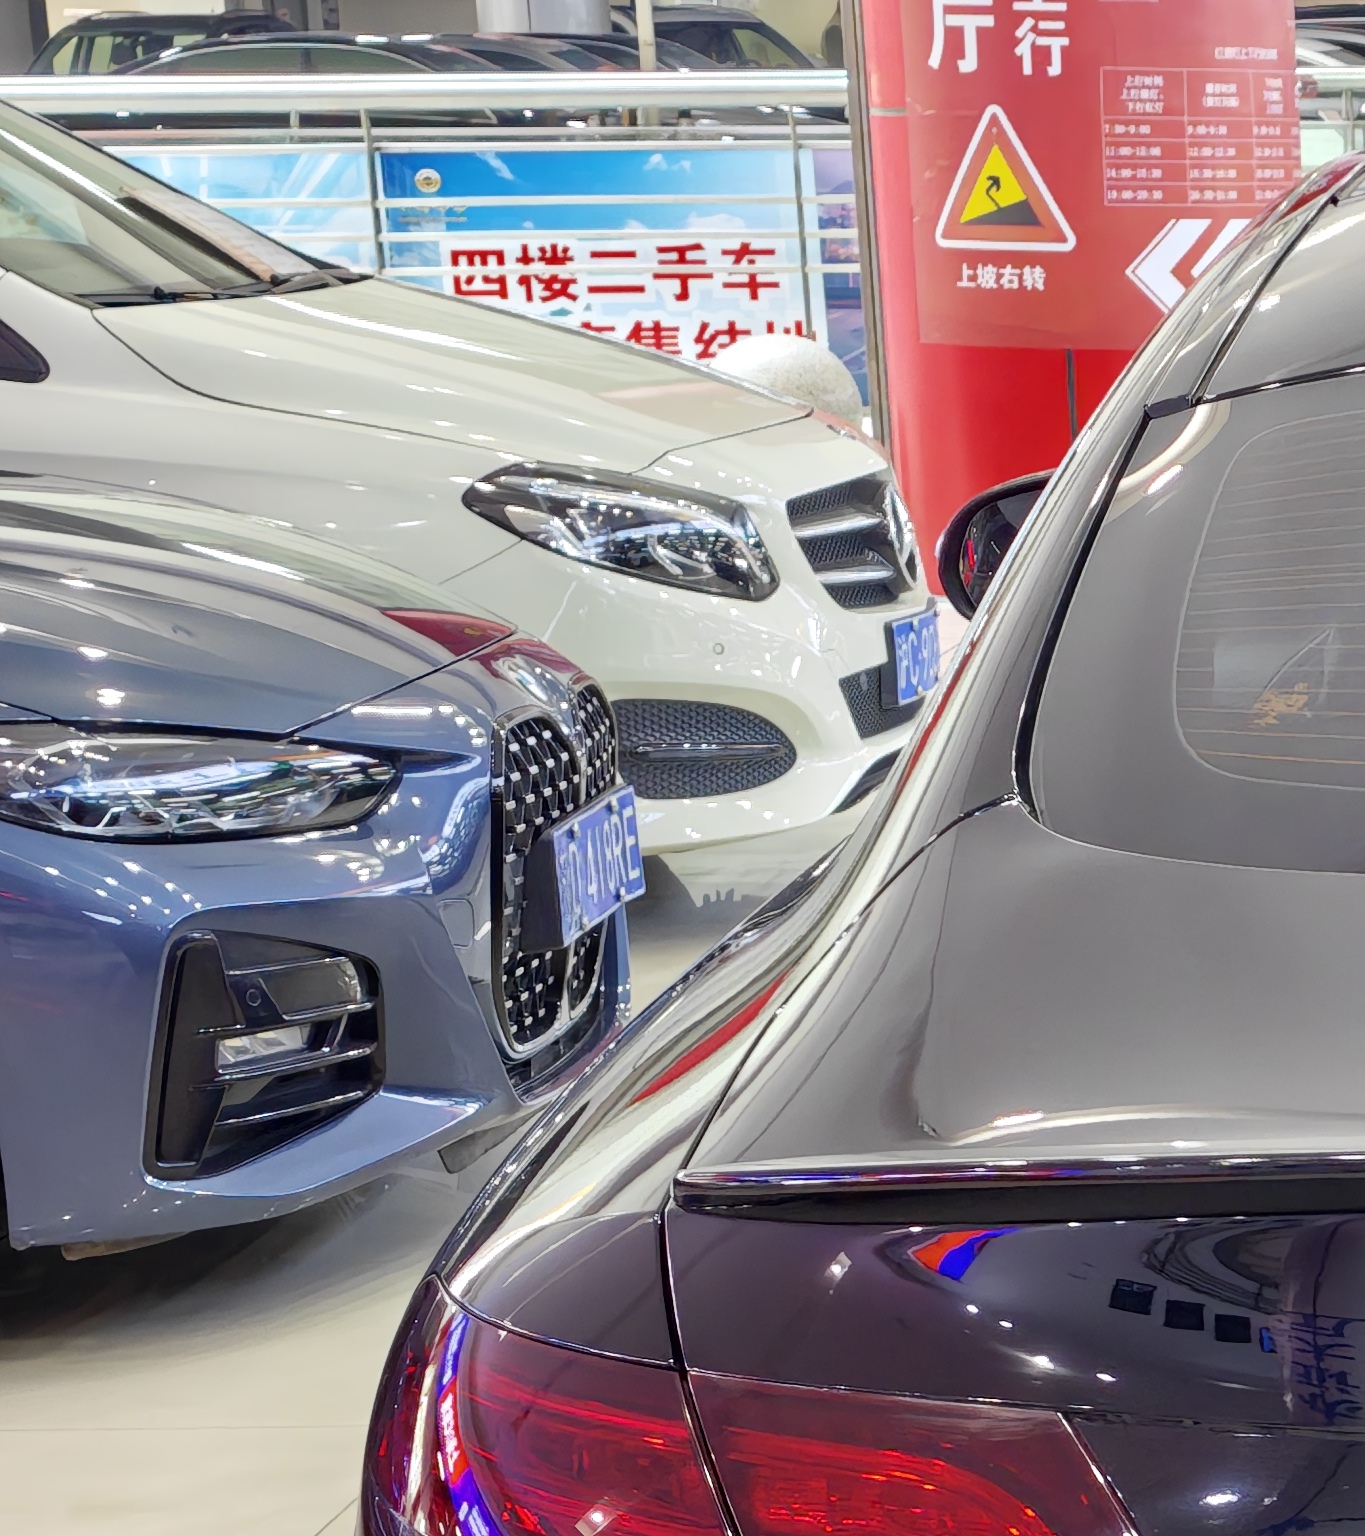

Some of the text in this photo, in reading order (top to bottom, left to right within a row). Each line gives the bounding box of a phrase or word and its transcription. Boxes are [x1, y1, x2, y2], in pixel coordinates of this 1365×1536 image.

[450, 242, 780, 302] 四楼二手车
[956, 262, 1046, 292] 上坡右转
